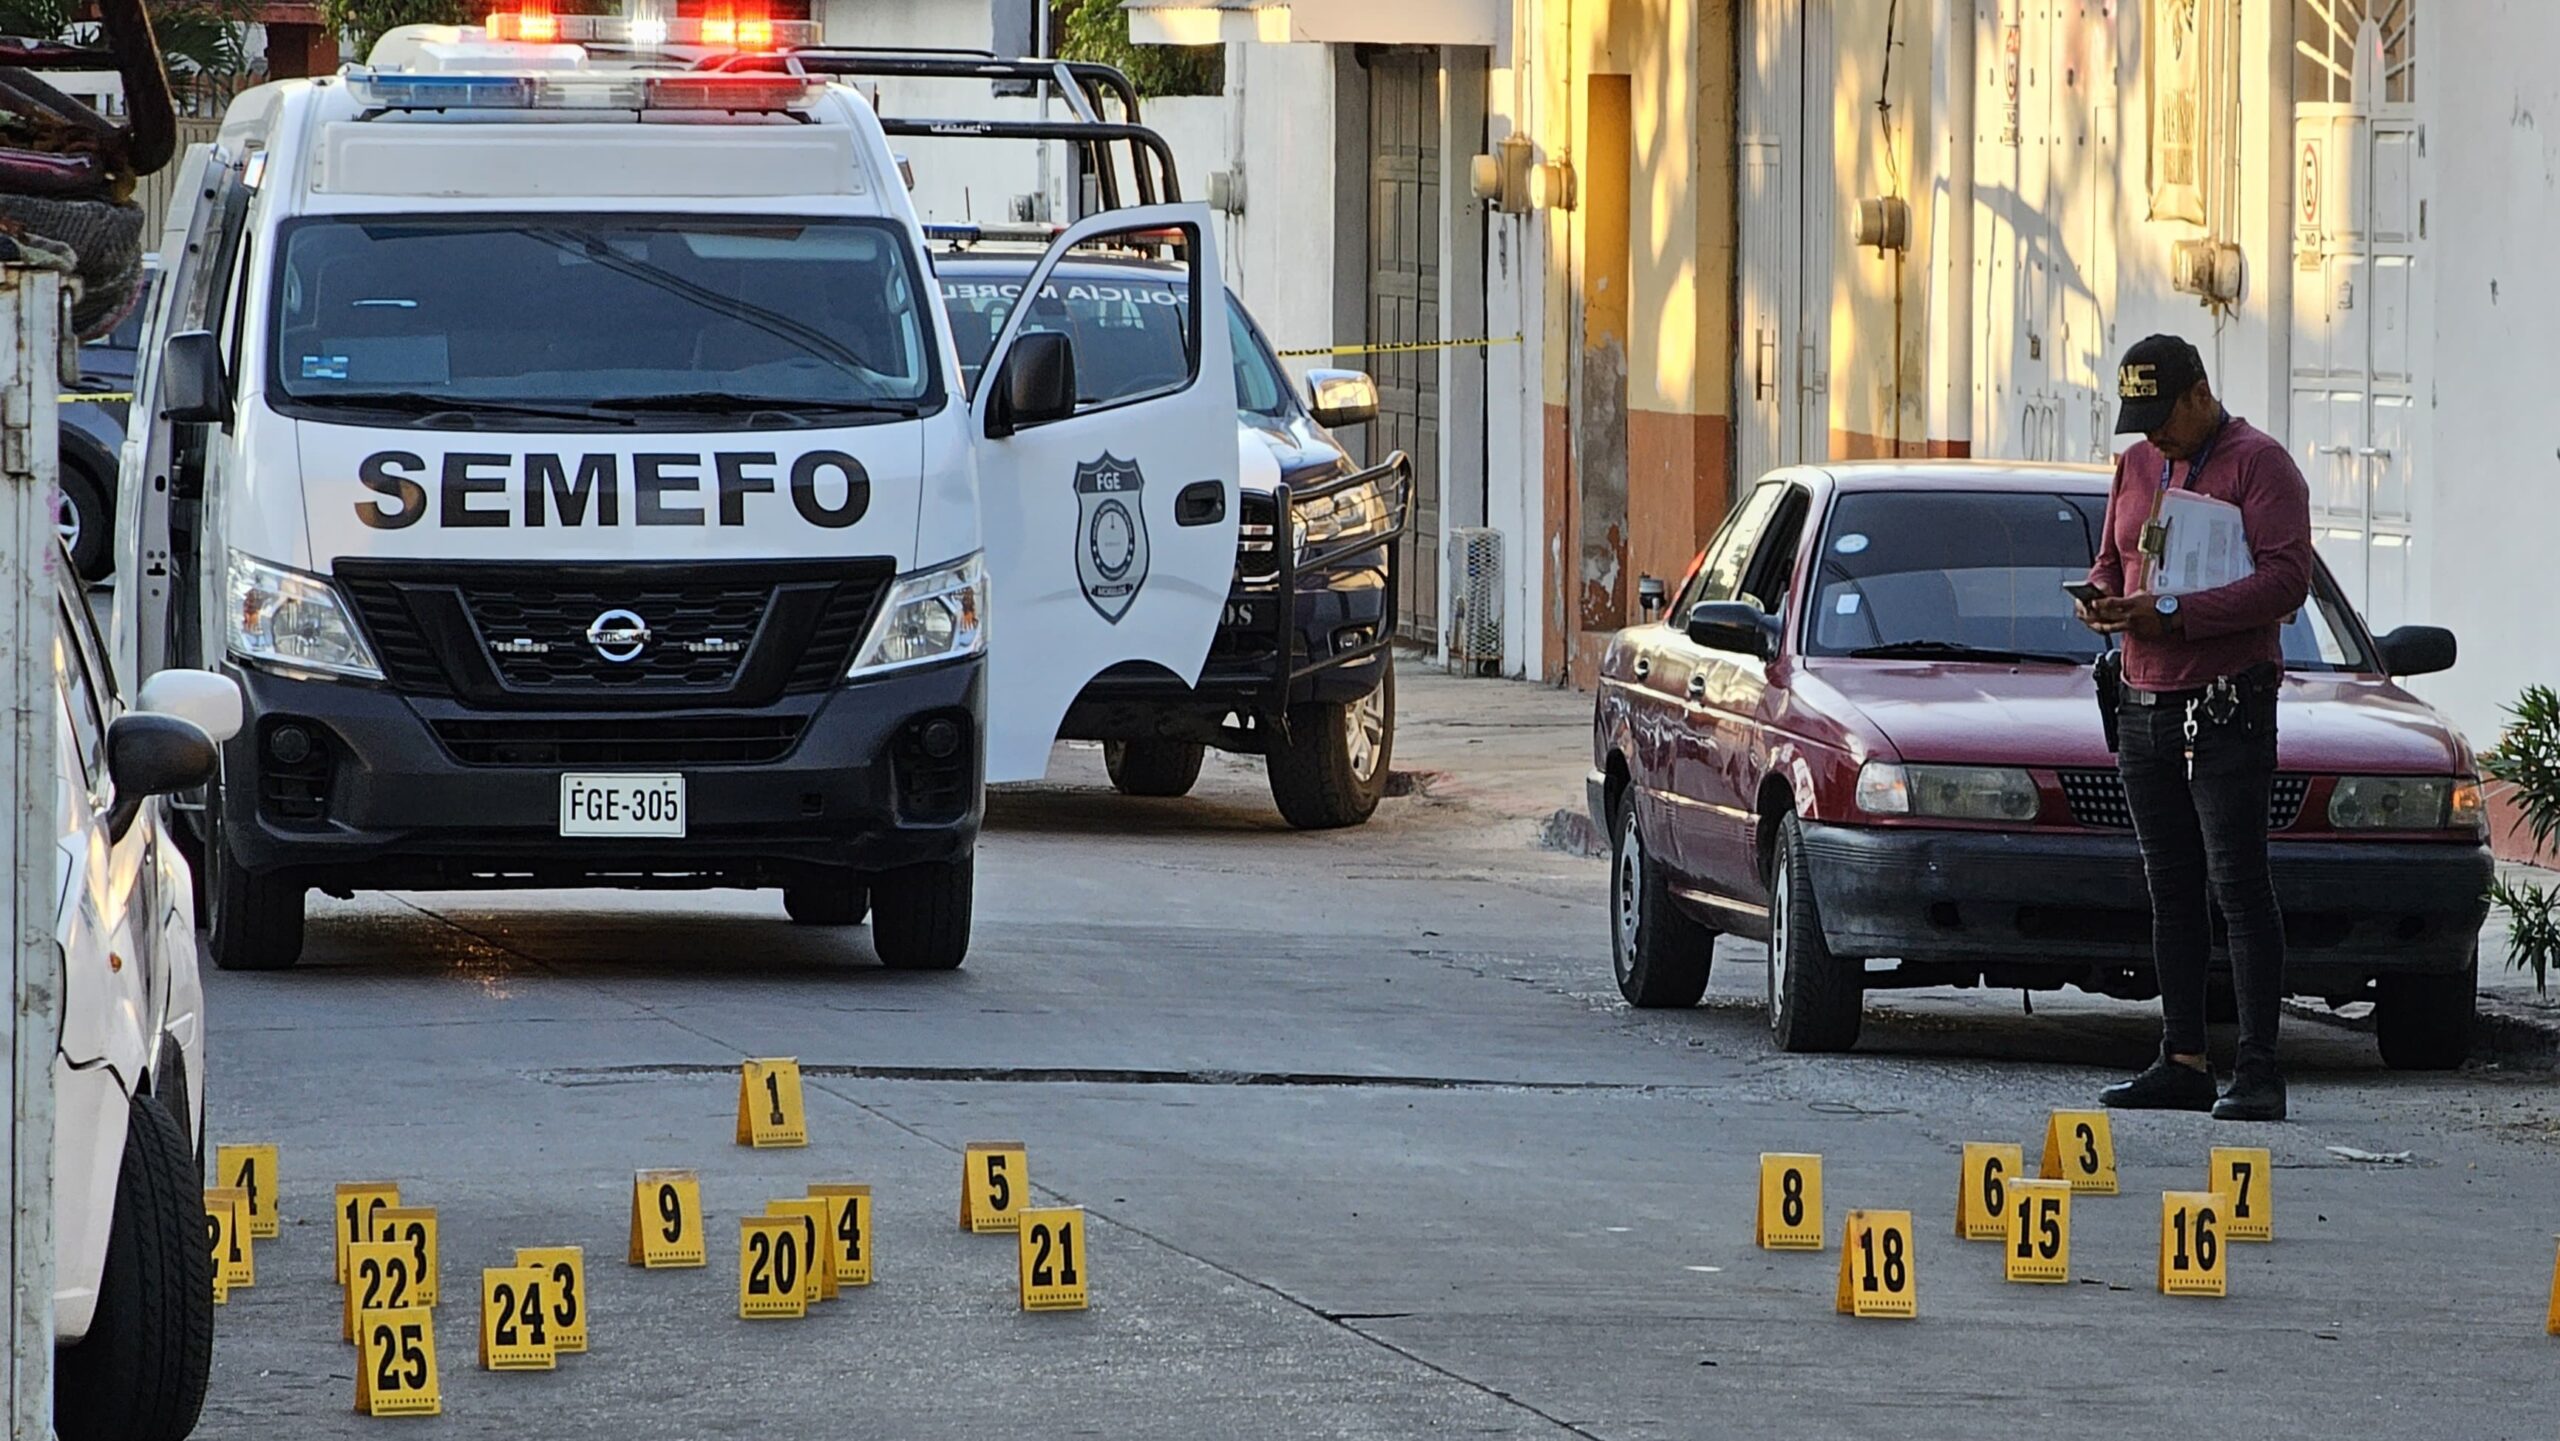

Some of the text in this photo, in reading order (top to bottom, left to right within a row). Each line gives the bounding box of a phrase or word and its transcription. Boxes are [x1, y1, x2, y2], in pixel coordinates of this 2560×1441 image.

[354, 448, 871, 530] SEMEFO
[1096, 472, 1121, 491] FGE
[571, 788, 678, 822] FGE-305
[765, 1071, 785, 1126] 1
[2075, 1122, 2099, 1175] 3
[658, 1183, 682, 1244] 9
[986, 1154, 1010, 1212] 5
[1782, 1167, 1804, 1227] 8
[1983, 1156, 2004, 1218] 6
[2231, 1161, 2252, 1219] 7
[837, 1197, 861, 1261] 4
[1030, 1221, 1077, 1287] 21
[2017, 1196, 2061, 1260] 15
[2173, 1206, 2217, 1271] 16
[359, 1257, 409, 1309] 22
[748, 1230, 797, 1295] 20
[1860, 1226, 1906, 1293] 18
[492, 1282, 546, 1346] 24
[373, 1323, 427, 1391] 25
